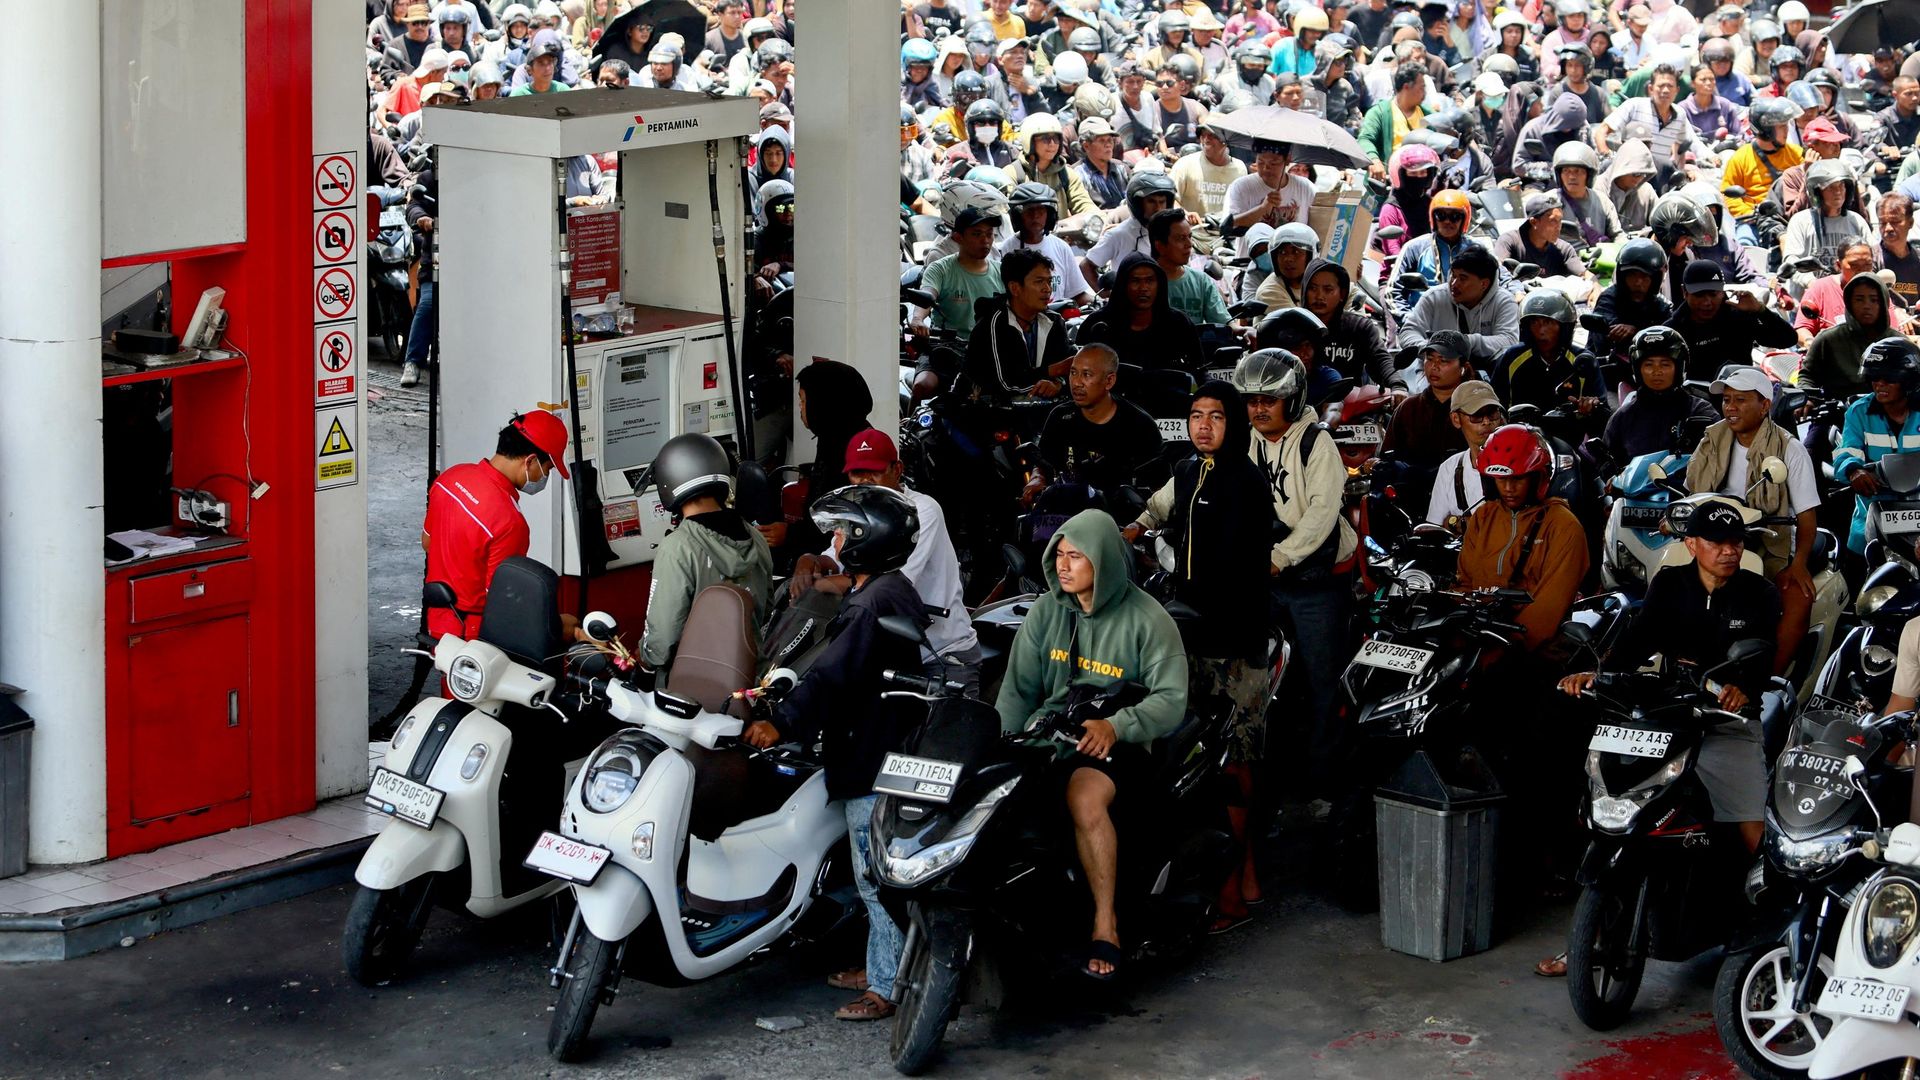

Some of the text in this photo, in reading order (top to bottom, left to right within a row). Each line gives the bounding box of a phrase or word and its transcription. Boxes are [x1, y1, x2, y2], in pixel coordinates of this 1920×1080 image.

[648, 119, 699, 133] PERTAMINA
[1330, 224, 1345, 252] AQUA
[710, 411, 735, 420] PERTALITE
[1158, 421, 1182, 432] 4232
[1885, 512, 1899, 522] DK
[664, 704, 686, 714] HONDA
[1593, 725, 1673, 746] DK 3112 AAS
[1783, 753, 1799, 769] DK
[1798, 753, 1832, 773] 3802
[902, 805, 923, 813] HONDA
[1655, 808, 1676, 828] HONDA
[539, 835, 556, 850] DK
[1828, 979, 1848, 995] DK
[1850, 982, 1885, 1000] 2732
